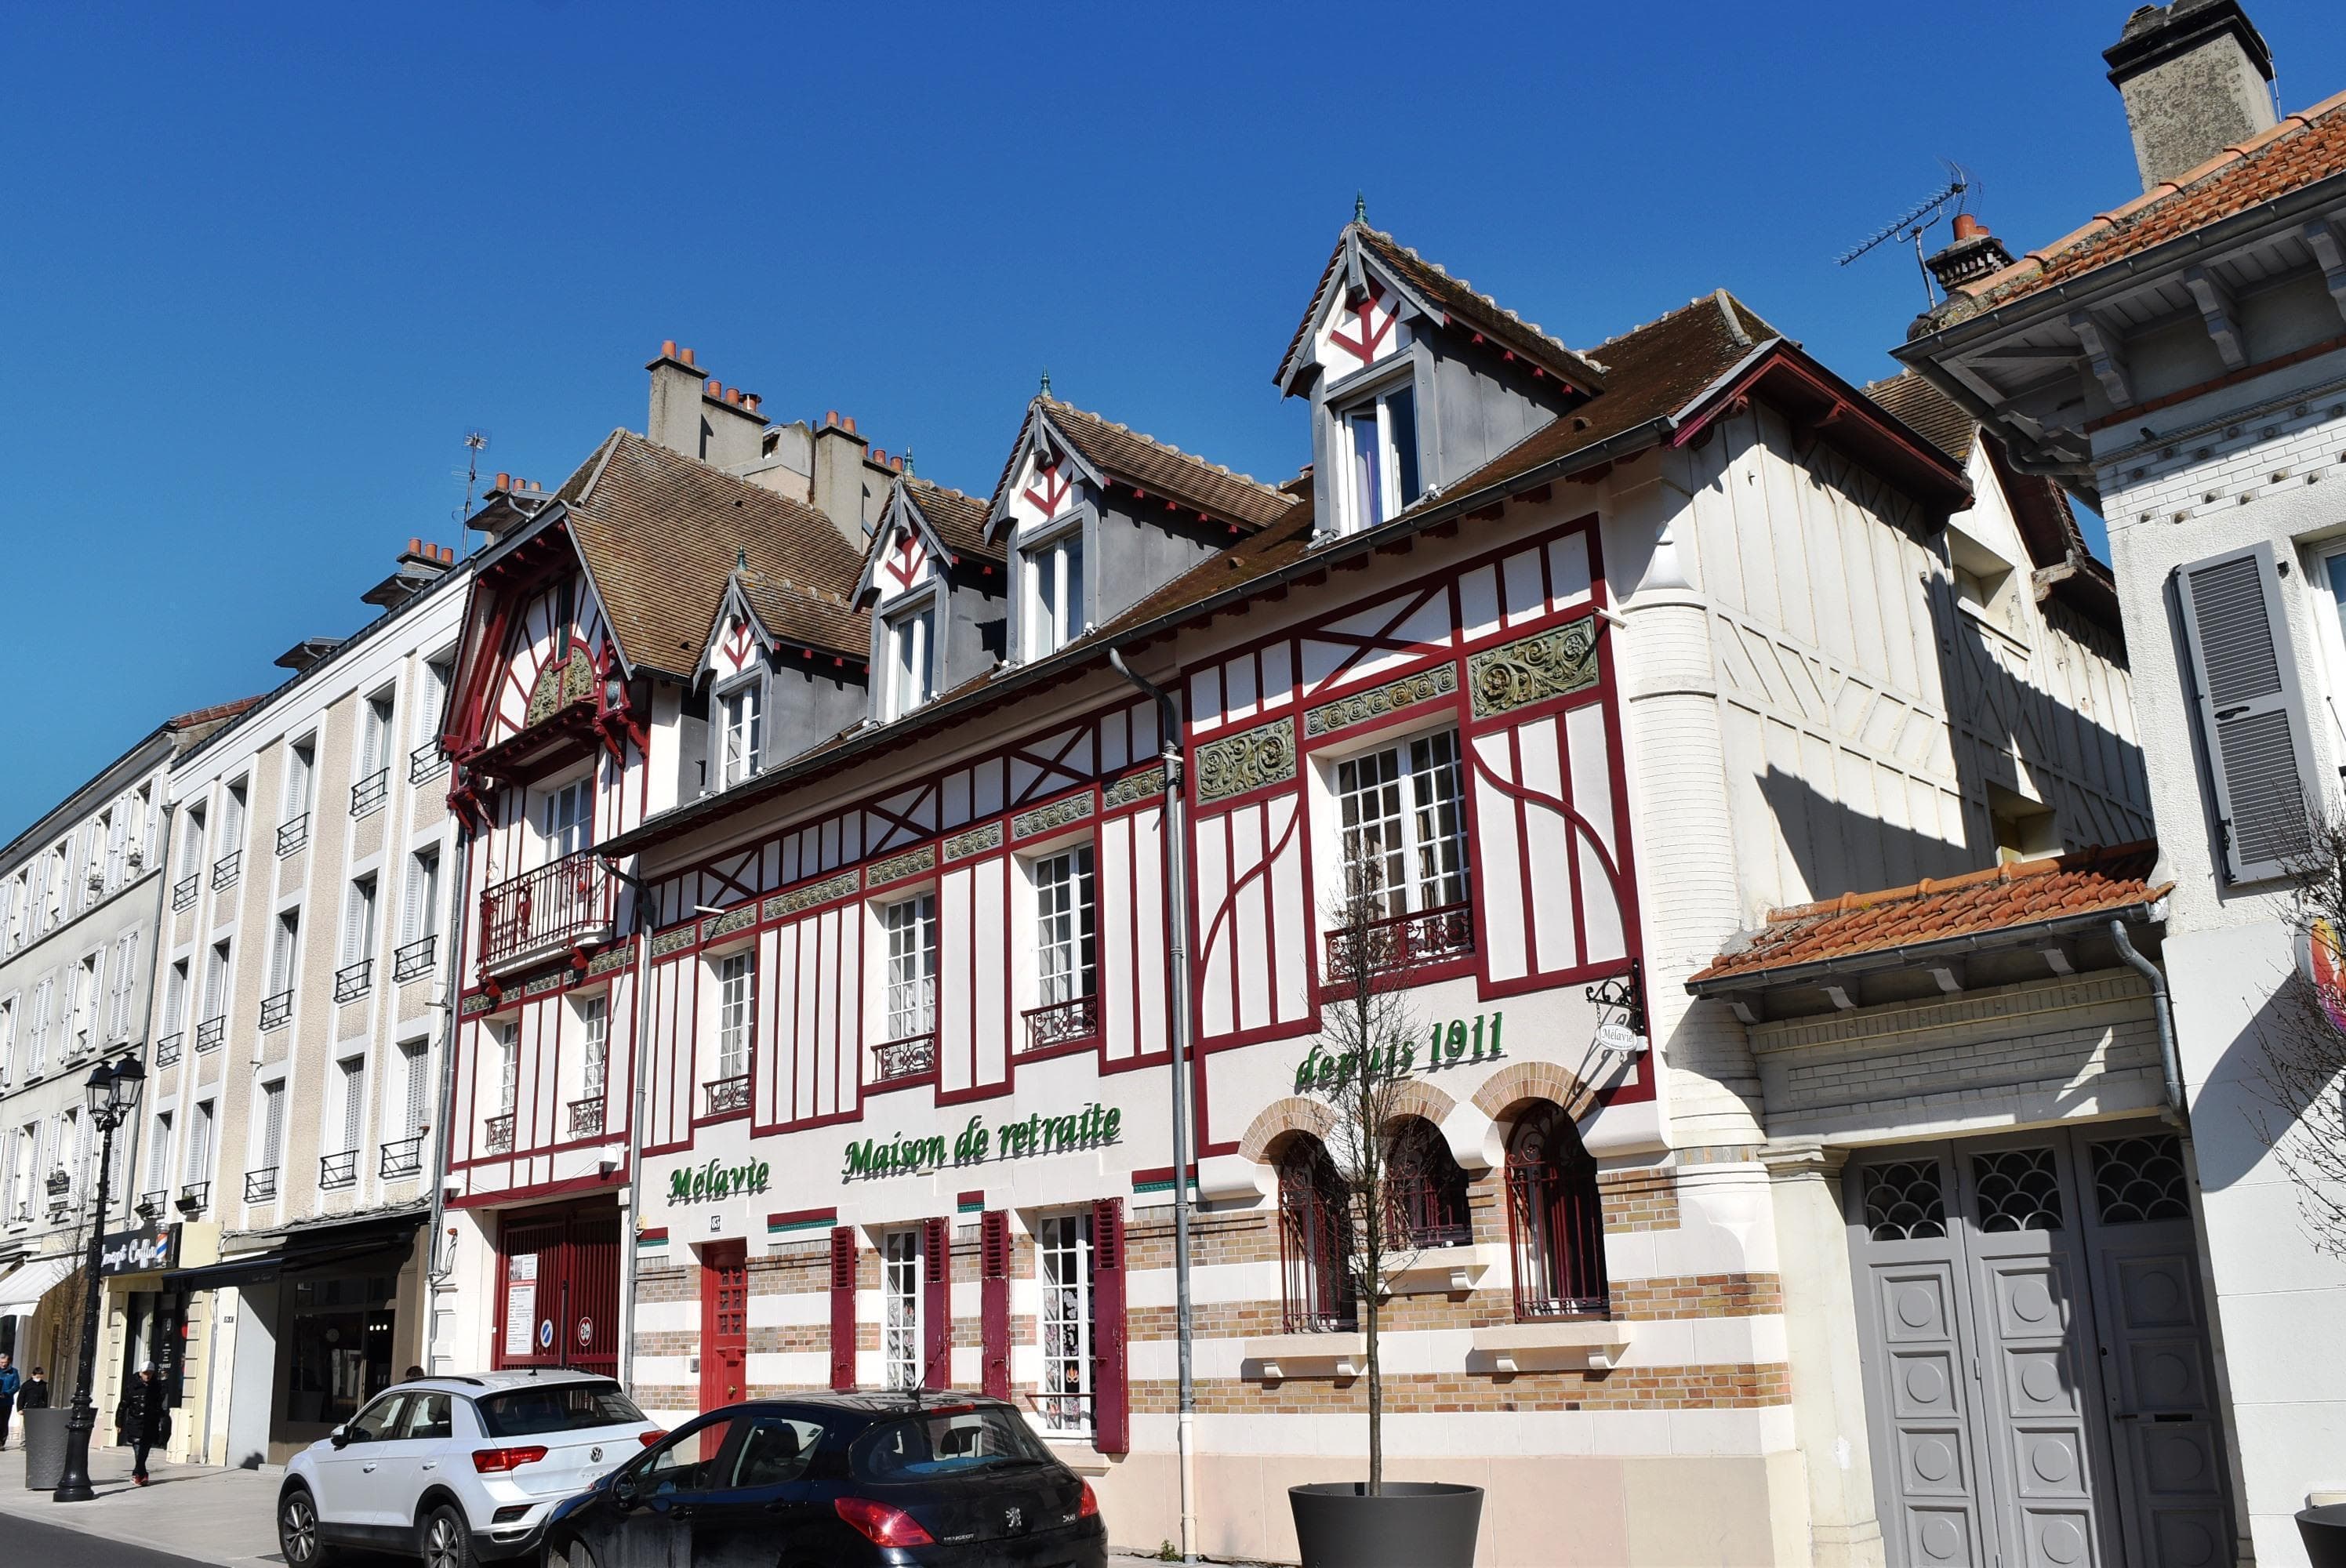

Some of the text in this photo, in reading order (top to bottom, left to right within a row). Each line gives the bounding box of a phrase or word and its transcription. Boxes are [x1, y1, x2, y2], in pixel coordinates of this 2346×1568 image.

[1296, 1011, 1504, 1089] depuis 1911
[1602, 1028, 1633, 1043] Mélavie
[841, 1102, 1121, 1175] Maison de retraite
[666, 1156, 769, 1199] Mélavie
